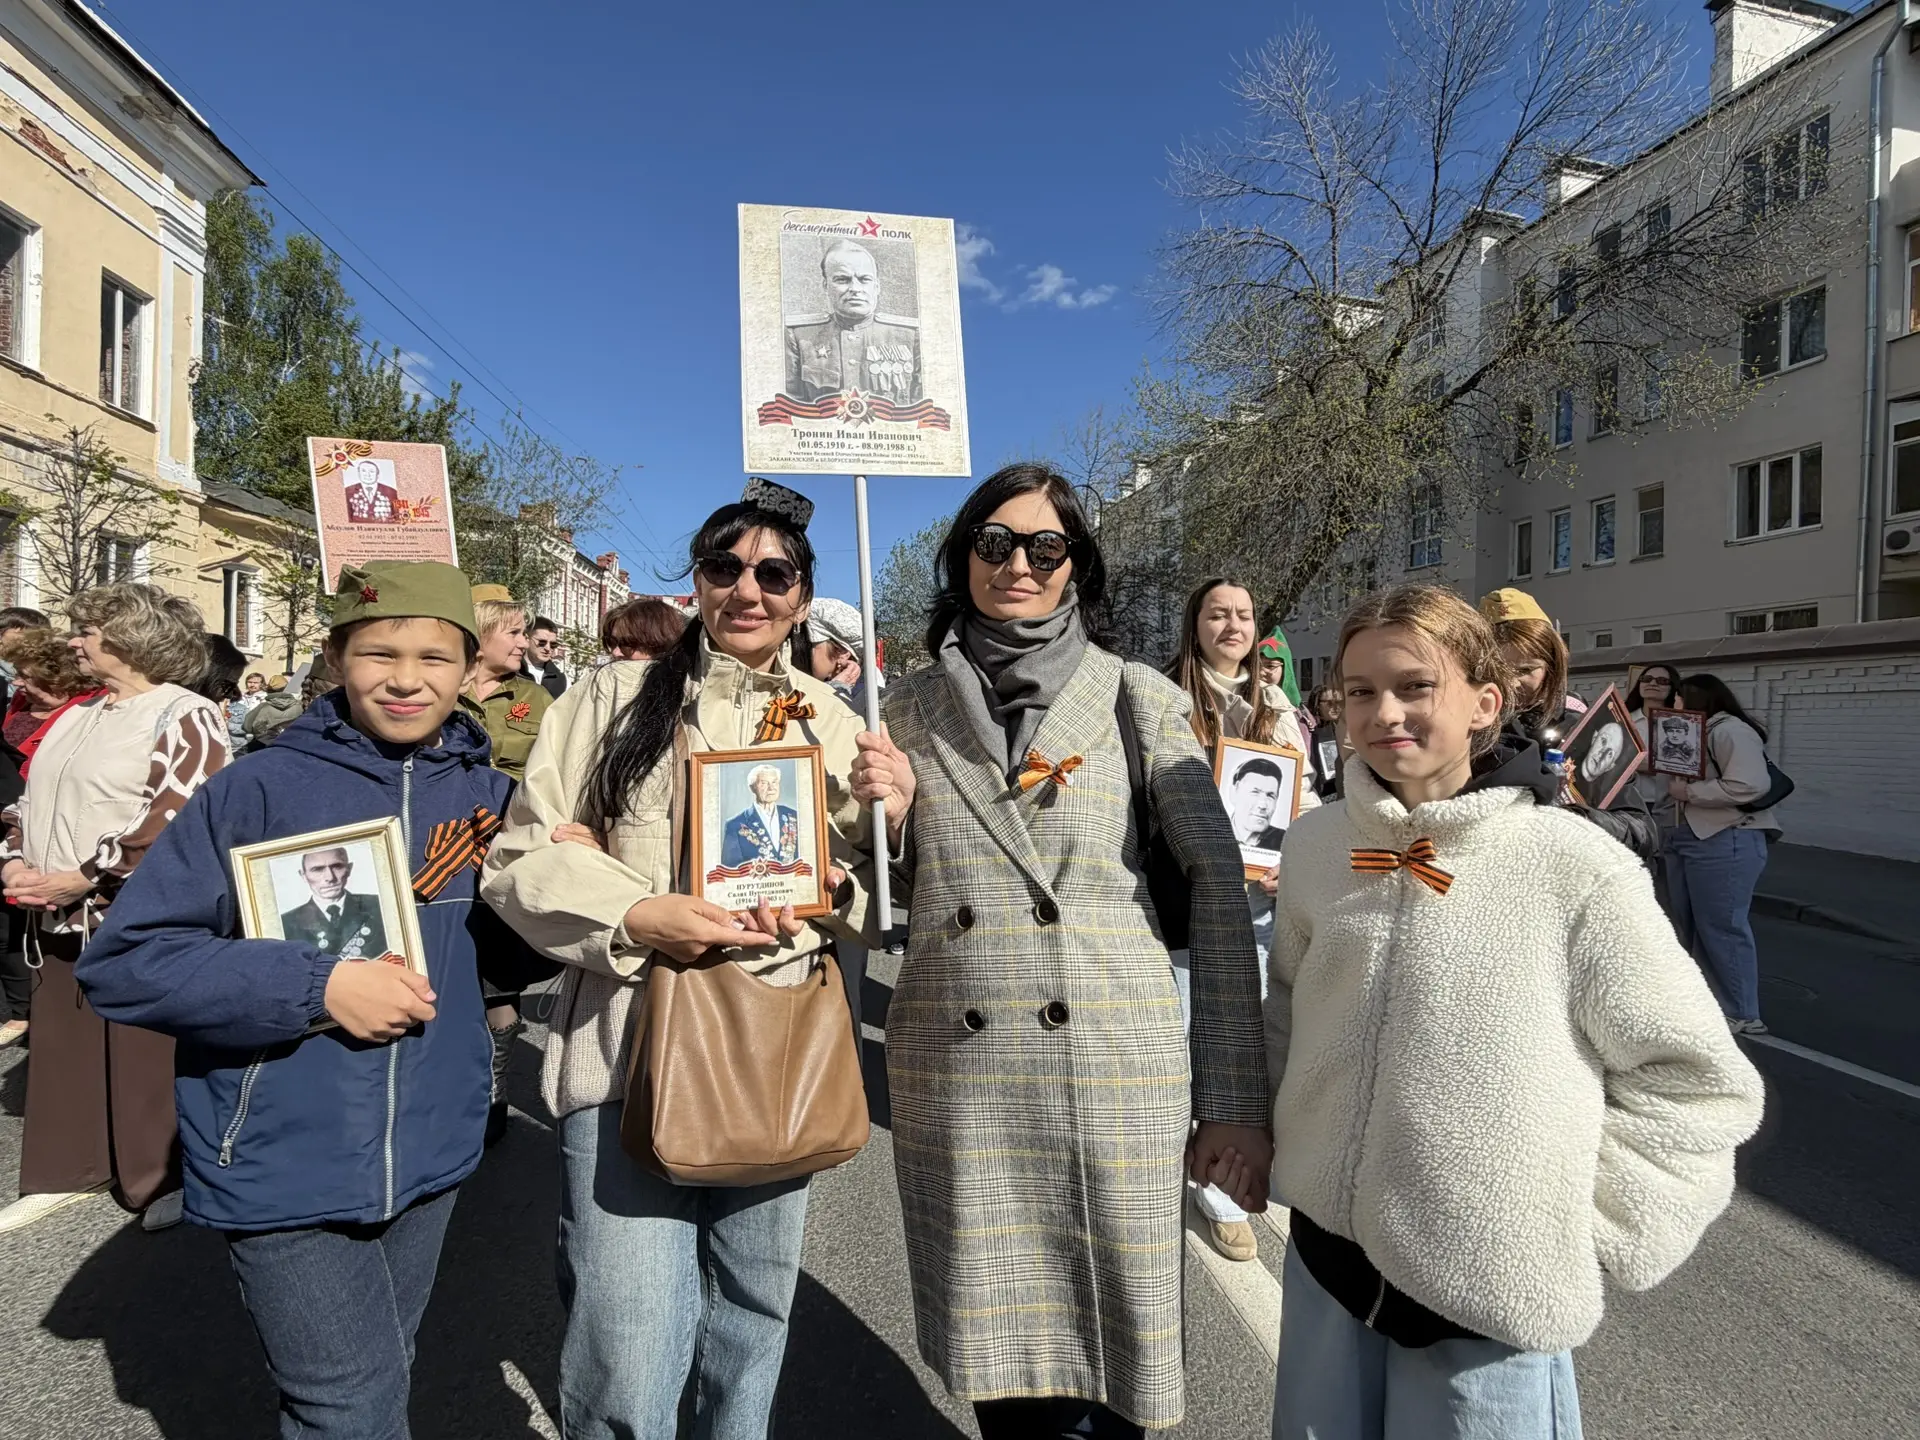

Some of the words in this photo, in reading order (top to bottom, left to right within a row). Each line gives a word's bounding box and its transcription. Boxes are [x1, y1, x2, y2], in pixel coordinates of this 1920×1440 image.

[791, 428, 833, 440] Тронин
[837, 429, 864, 440] Иван
[869, 430, 922, 441] Иванович
[798, 441, 846, 450] (01.05.1910
[861, 442, 905, 451] 08.09.1988
[736, 881, 785, 890] НУРУТДИНОВ
